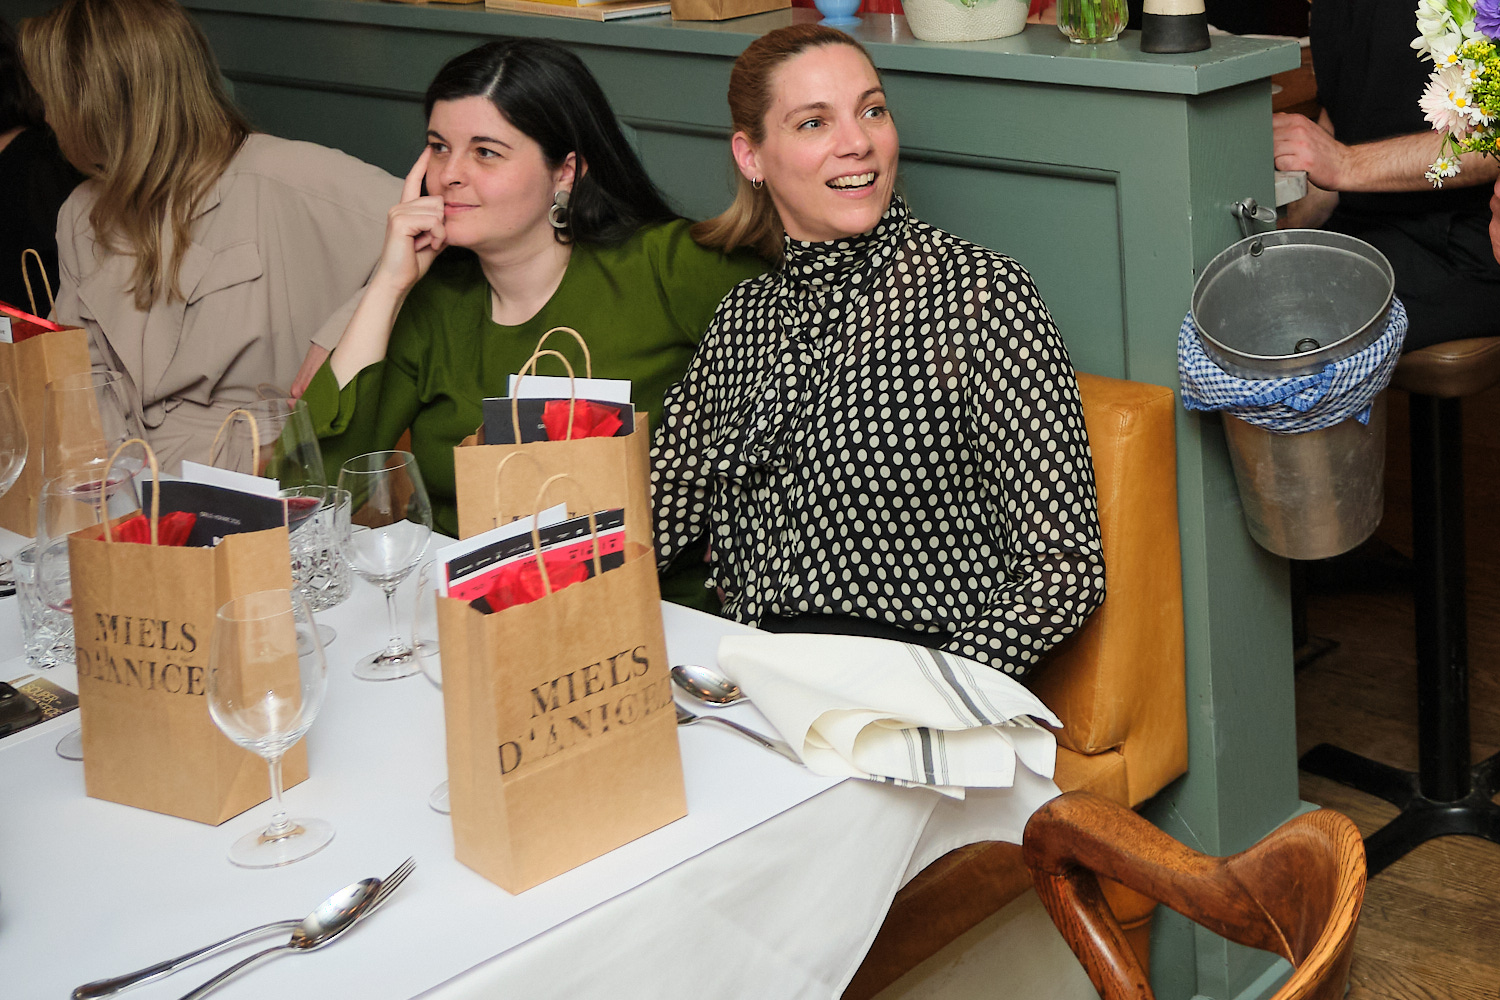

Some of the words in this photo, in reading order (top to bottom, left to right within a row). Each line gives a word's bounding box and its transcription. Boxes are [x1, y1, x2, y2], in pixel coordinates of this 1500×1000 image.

[95, 612, 198, 653] MIELS
[76, 646, 218, 697] D'ANICE
[529, 645, 650, 720] MIELS
